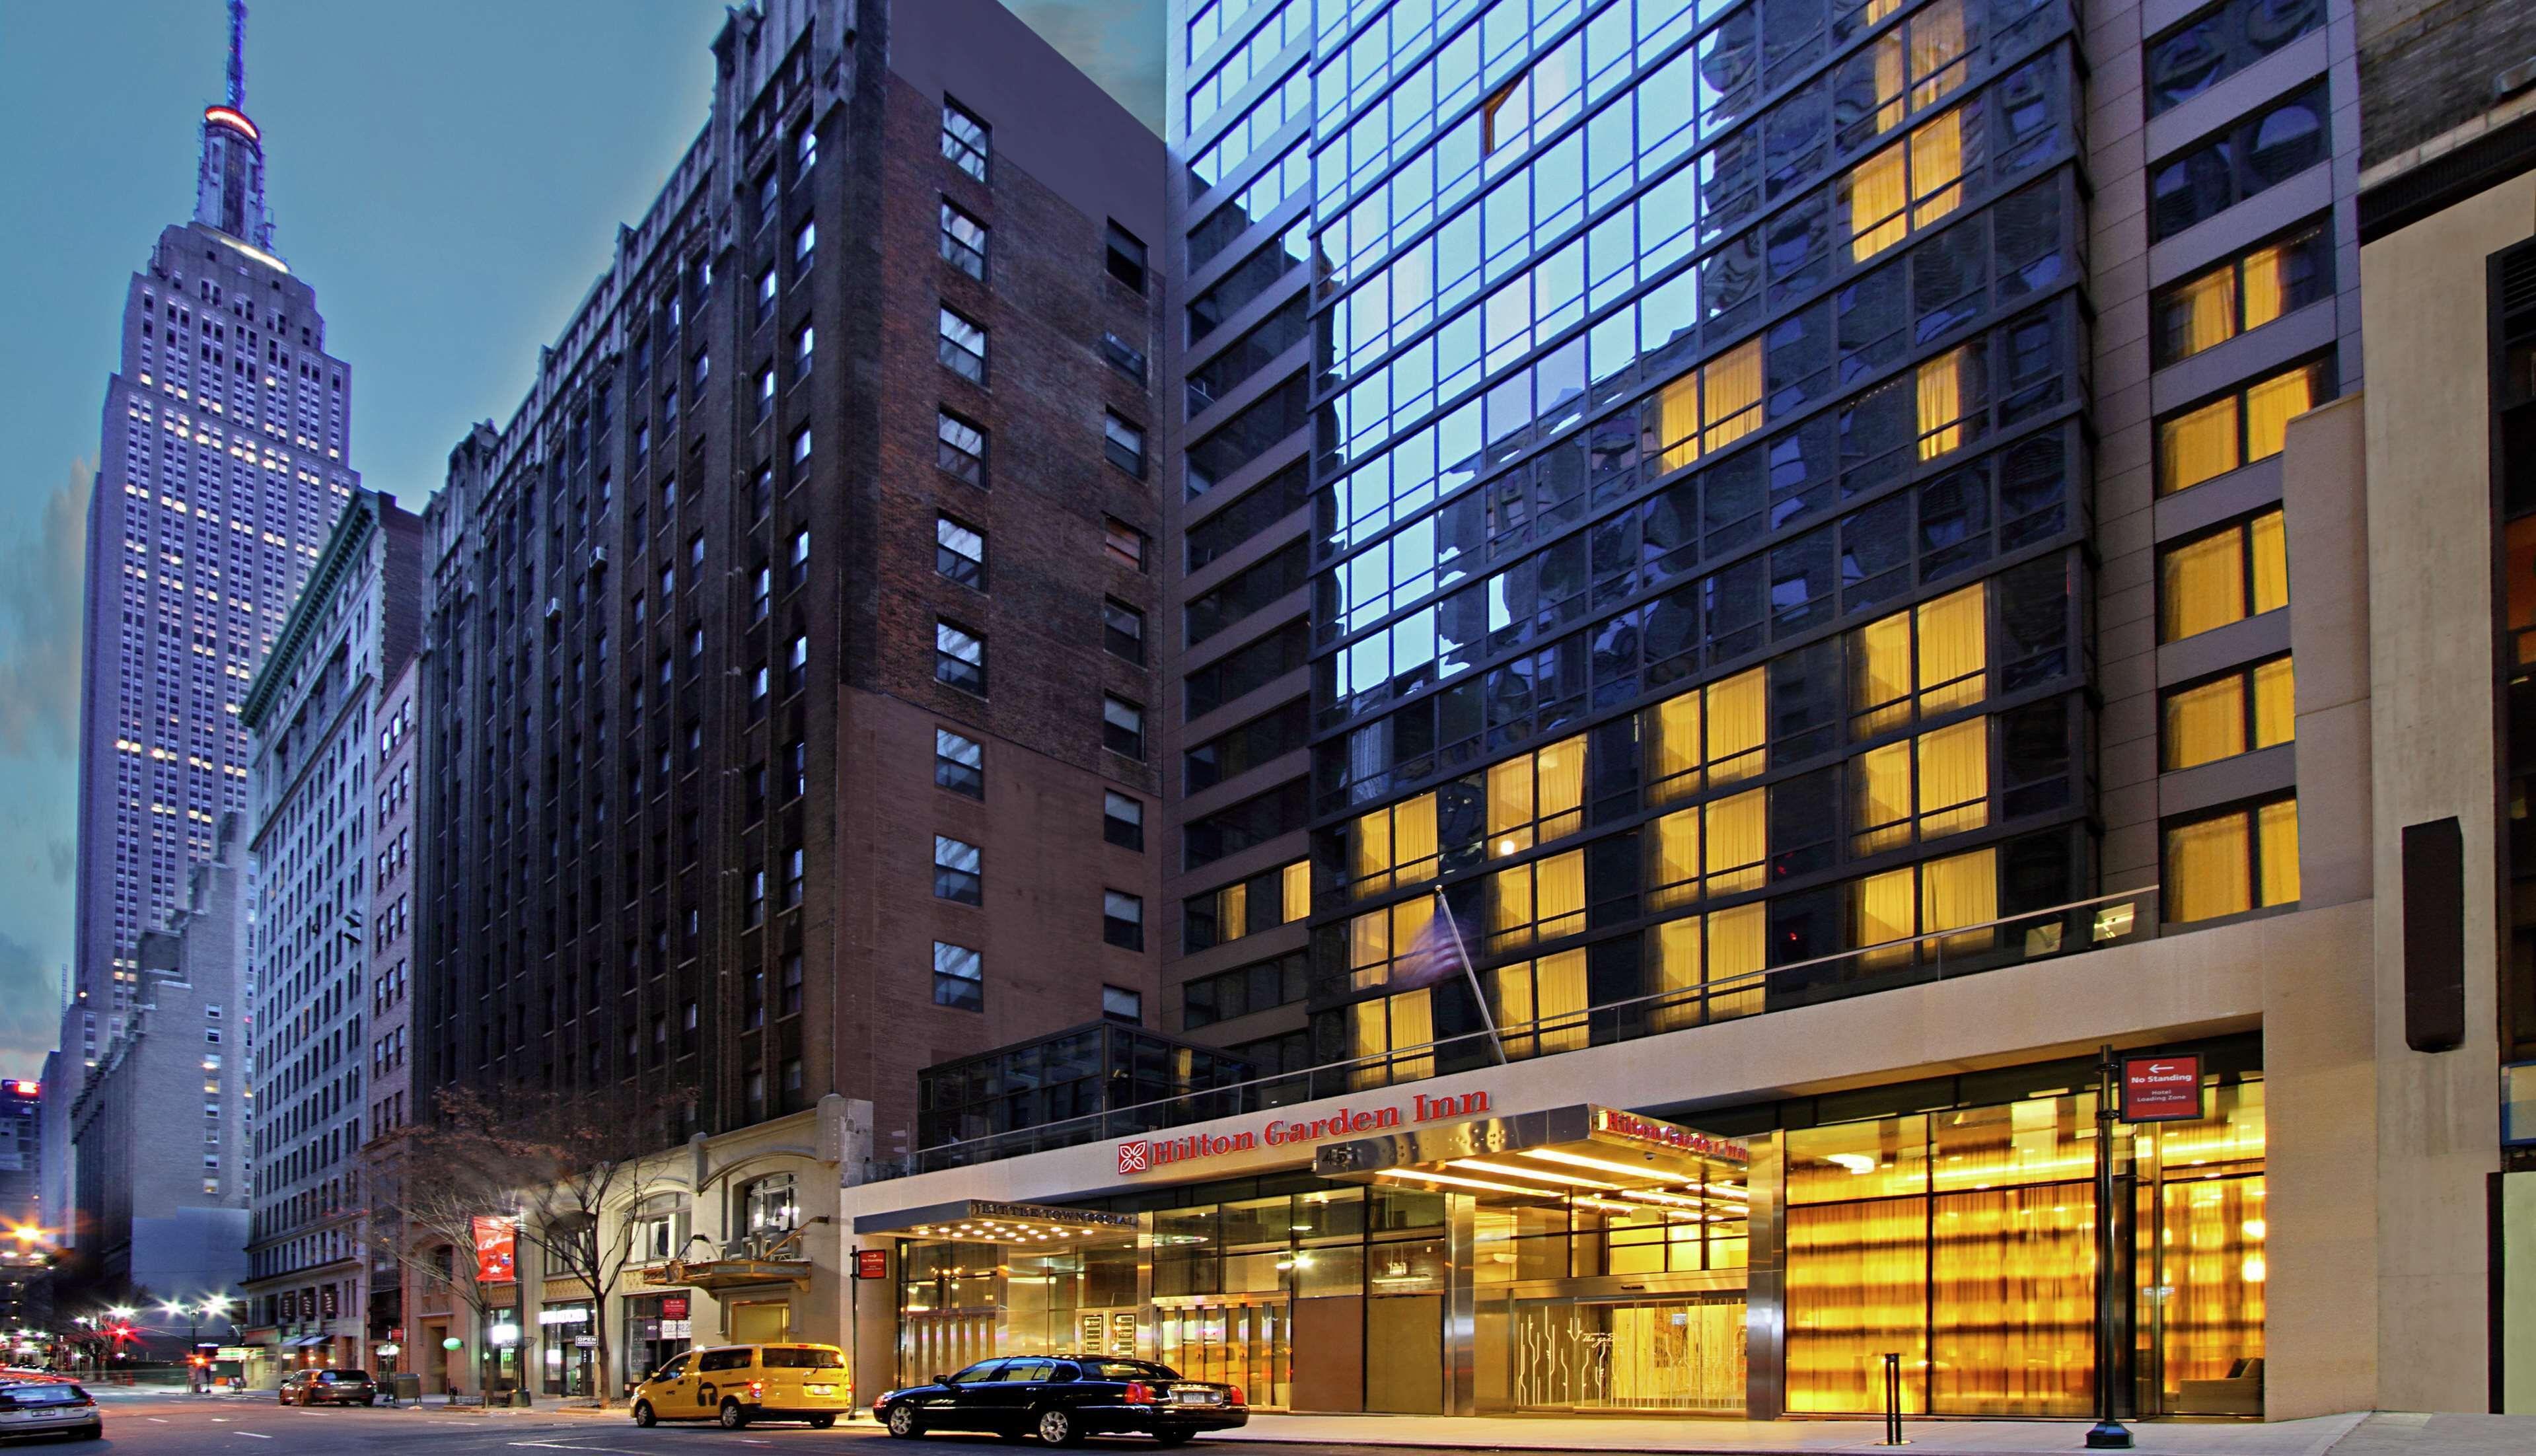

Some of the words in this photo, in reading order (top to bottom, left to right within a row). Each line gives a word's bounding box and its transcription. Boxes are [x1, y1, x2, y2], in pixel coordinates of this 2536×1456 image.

[2148, 1074, 2192, 1083] Standing
[1152, 1132, 1256, 1166] Hilton
[1263, 1107, 1400, 1147] Garden
[1413, 1091, 1491, 1122] Inn
[1607, 1110, 1661, 1140] Hilton
[1665, 1126, 1720, 1154] Garden
[1724, 1139, 1749, 1163] Inn
[982, 1202, 1039, 1218] LITTLE
[1046, 1210, 1085, 1221] TOWN
[1088, 1213, 1138, 1226] SOCIAL
